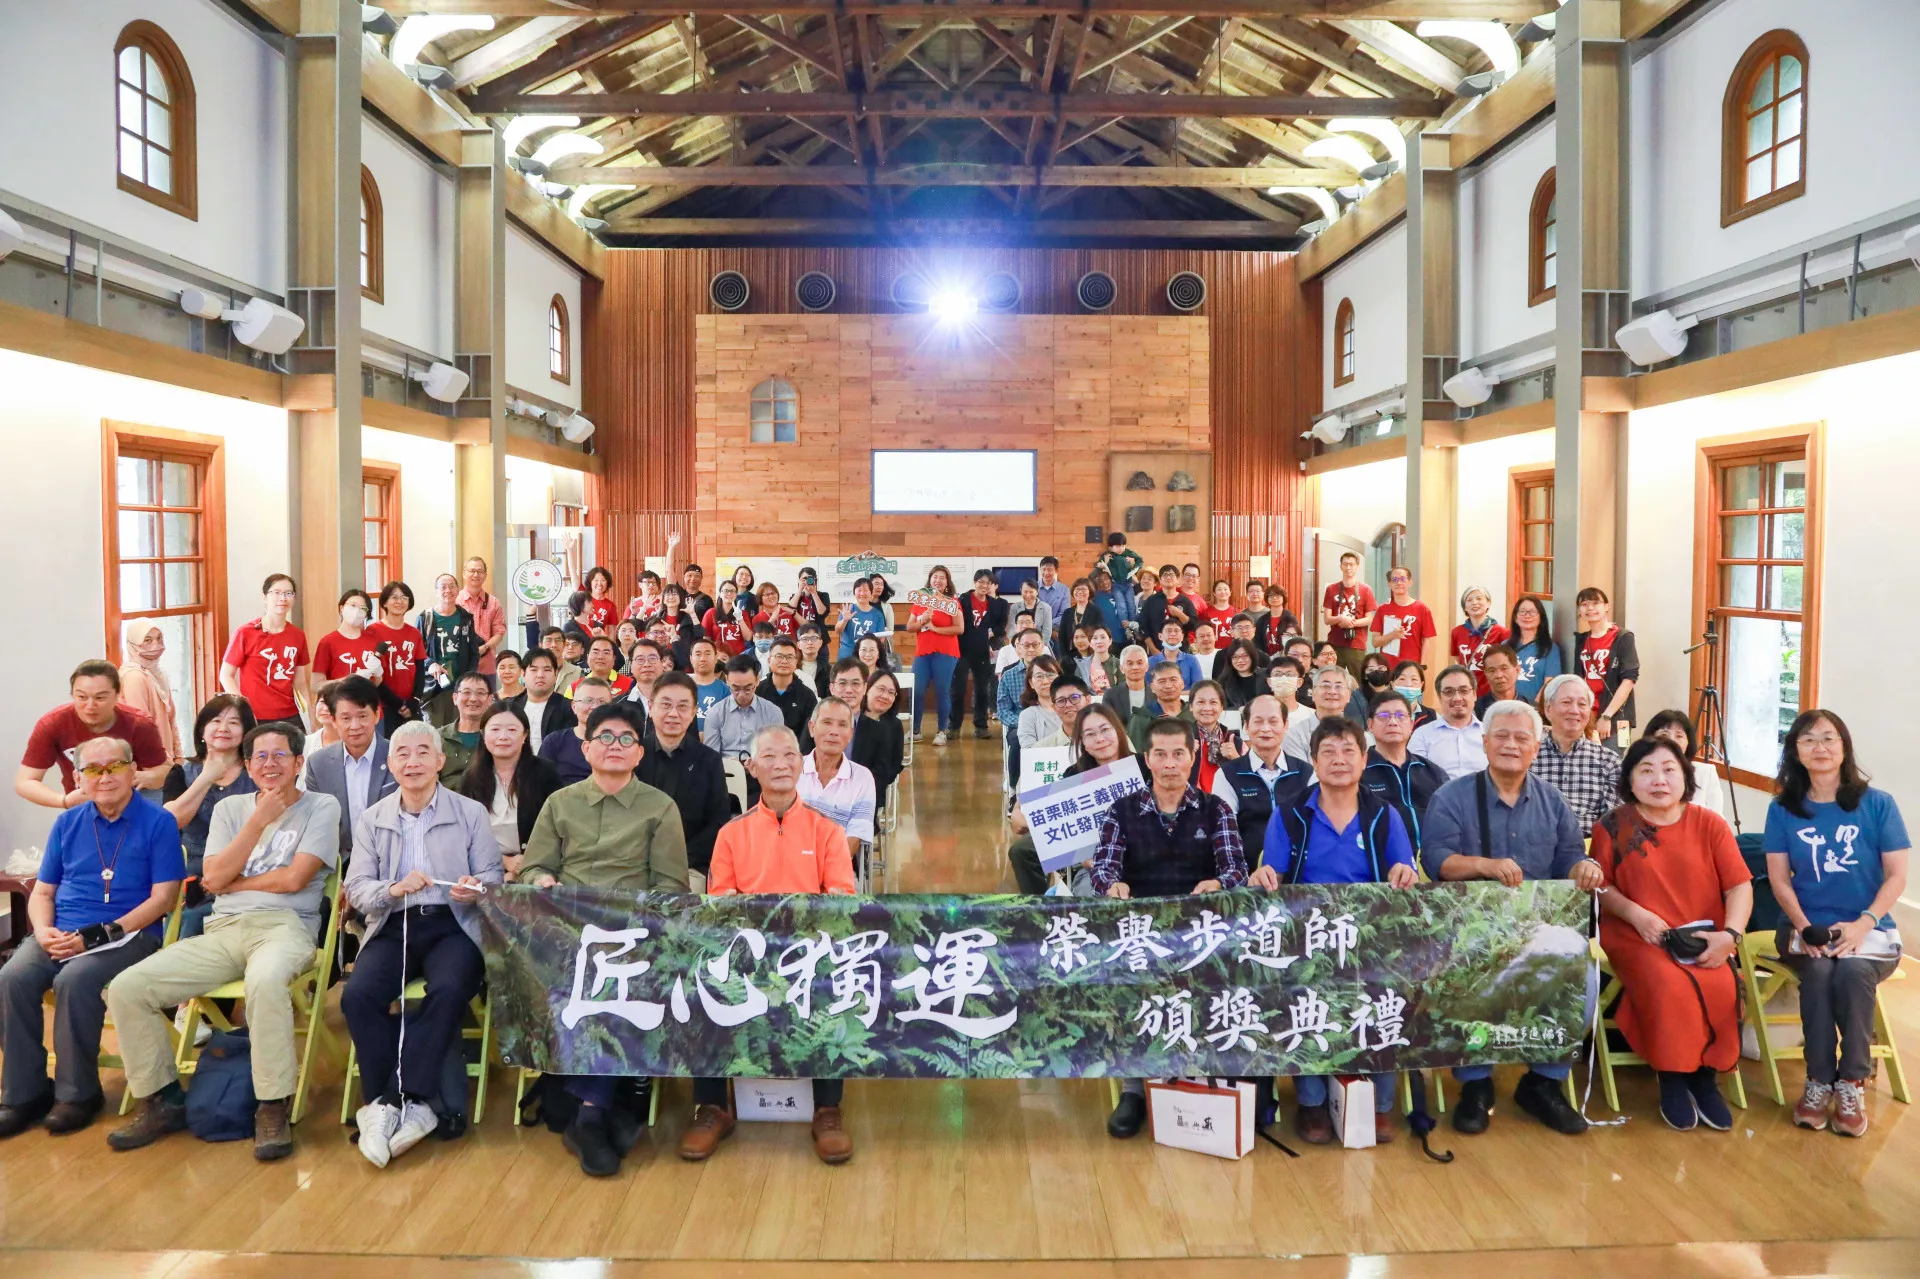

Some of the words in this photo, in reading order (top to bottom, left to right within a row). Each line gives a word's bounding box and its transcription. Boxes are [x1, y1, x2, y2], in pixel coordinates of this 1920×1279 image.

[838, 561, 897, 574] 走在山海之間
[1034, 760, 1059, 773] 農村
[1029, 777, 1142, 829] 苗栗縣三義觀光
[1039, 906, 1359, 973] 榮譽步道師
[561, 923, 1019, 1041] 匠心獨運
[1134, 986, 1411, 1054] 頒獎典禮
